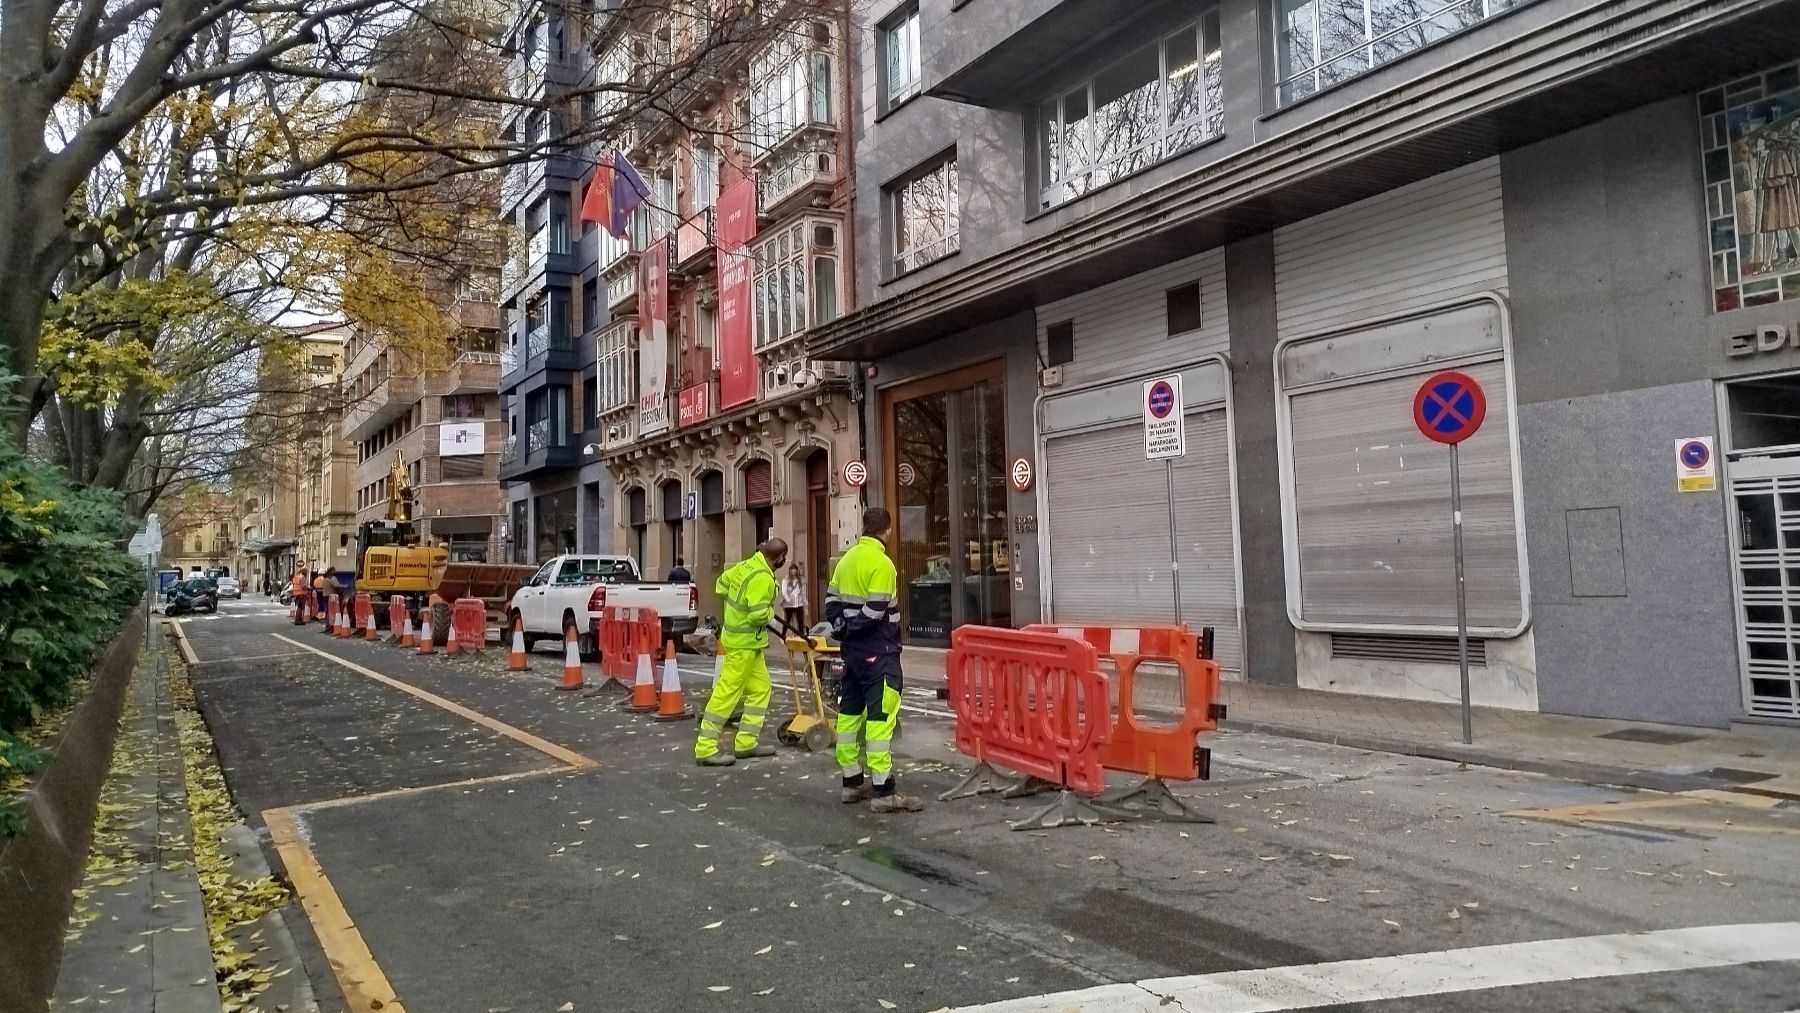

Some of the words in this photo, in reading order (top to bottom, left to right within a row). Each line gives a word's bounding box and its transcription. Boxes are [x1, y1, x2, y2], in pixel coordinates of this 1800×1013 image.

[1726, 320, 1800, 357] EDI
[680, 405, 693, 420] PSOE
[1148, 420, 1177, 430] PARLAMENTO
[1156, 427, 1176, 436] NAVARRA
[1148, 445, 1179, 454] PARLAMENTUA
